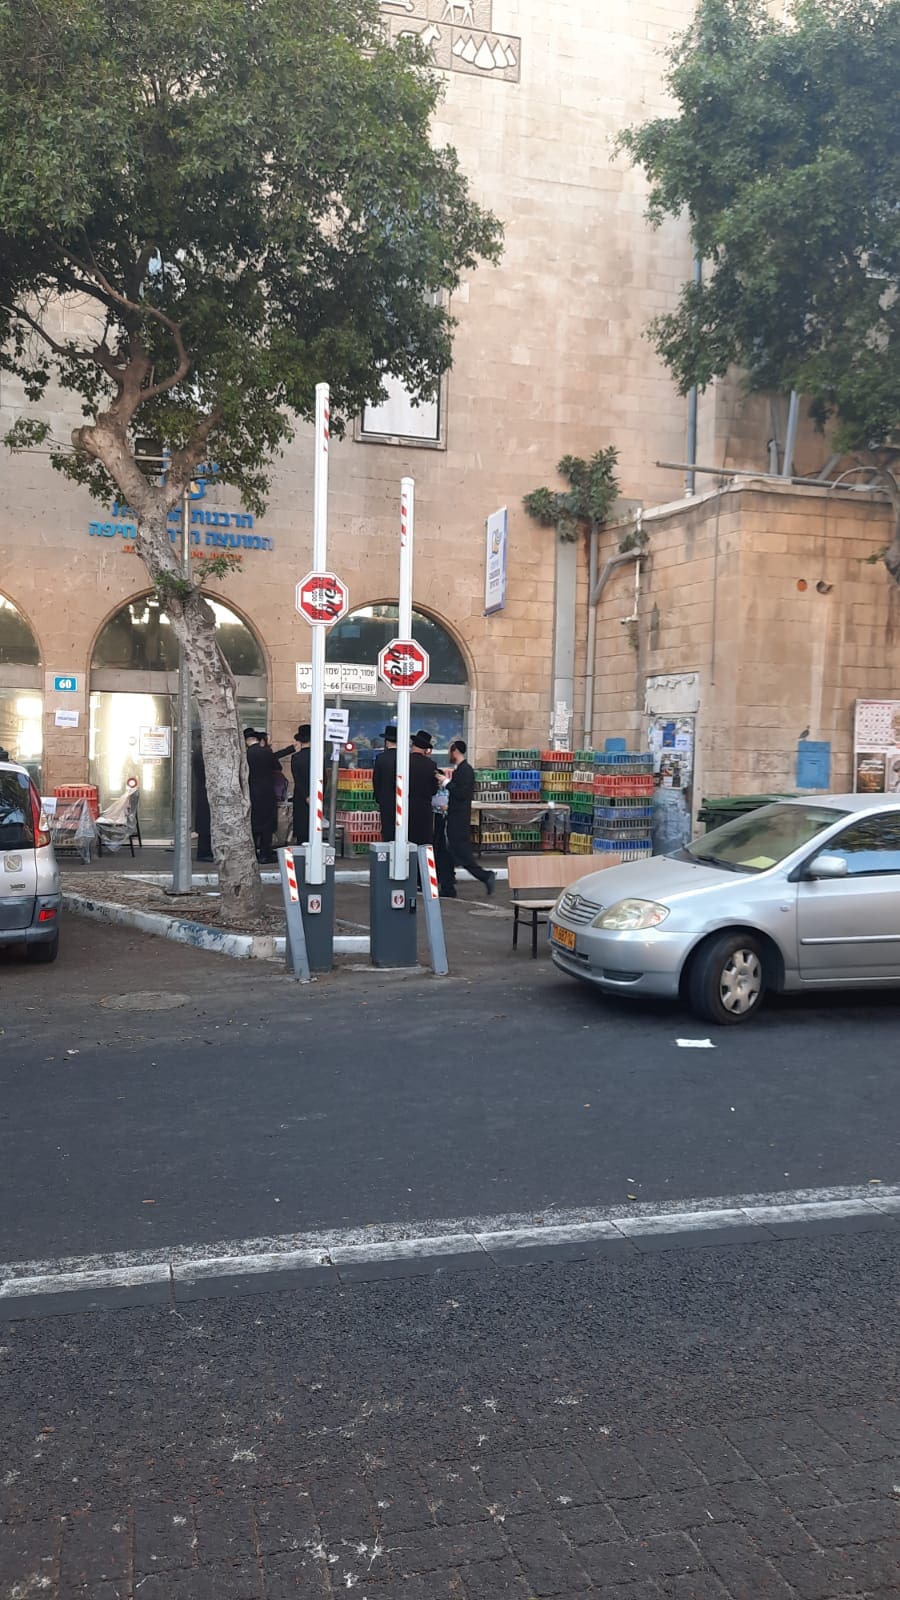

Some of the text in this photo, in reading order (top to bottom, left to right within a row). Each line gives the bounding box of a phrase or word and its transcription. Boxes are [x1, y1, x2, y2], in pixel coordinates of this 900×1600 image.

[191, 508, 254, 528] הרבנות
[88, 520, 137, 539] חיפה
[205, 530, 273, 551] המועצה
[59, 679, 72, 689] 60
